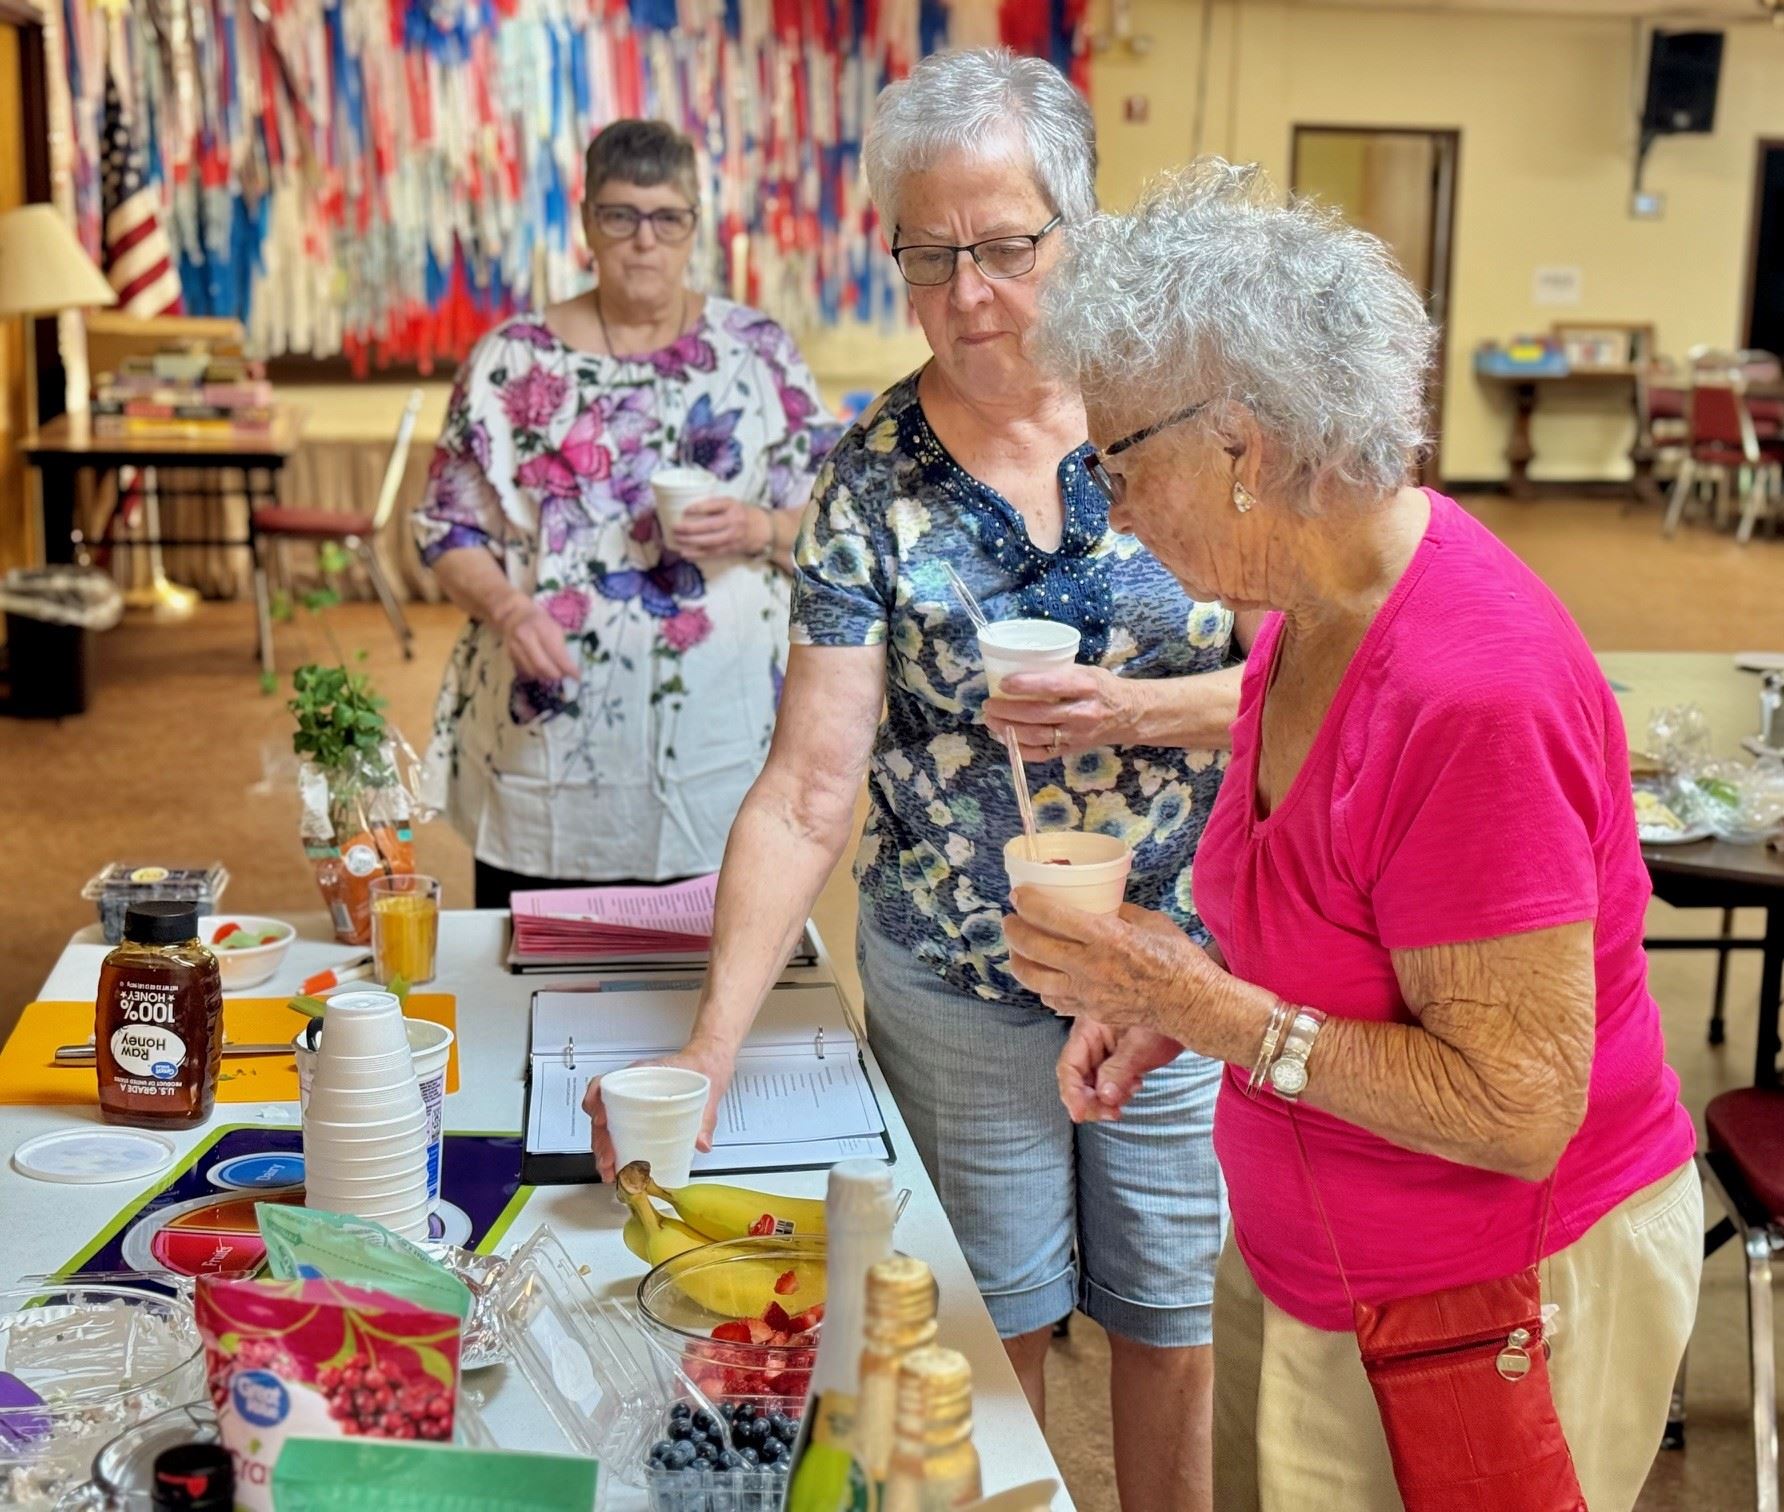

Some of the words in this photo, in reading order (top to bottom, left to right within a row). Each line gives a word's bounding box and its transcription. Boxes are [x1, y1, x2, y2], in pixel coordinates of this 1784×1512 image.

[126, 990, 166, 1003] HONEY
[120, 999, 176, 1023] 100%
[121, 1033, 166, 1051] Honey
[121, 1046, 149, 1061] Raw
[120, 1083, 126, 1091] A
[127, 1084, 157, 1095] GRADE
[158, 1086, 175, 1096] U.S.
[255, 1163, 286, 1181] Dairy
[200, 1246, 234, 1267] Fruits
